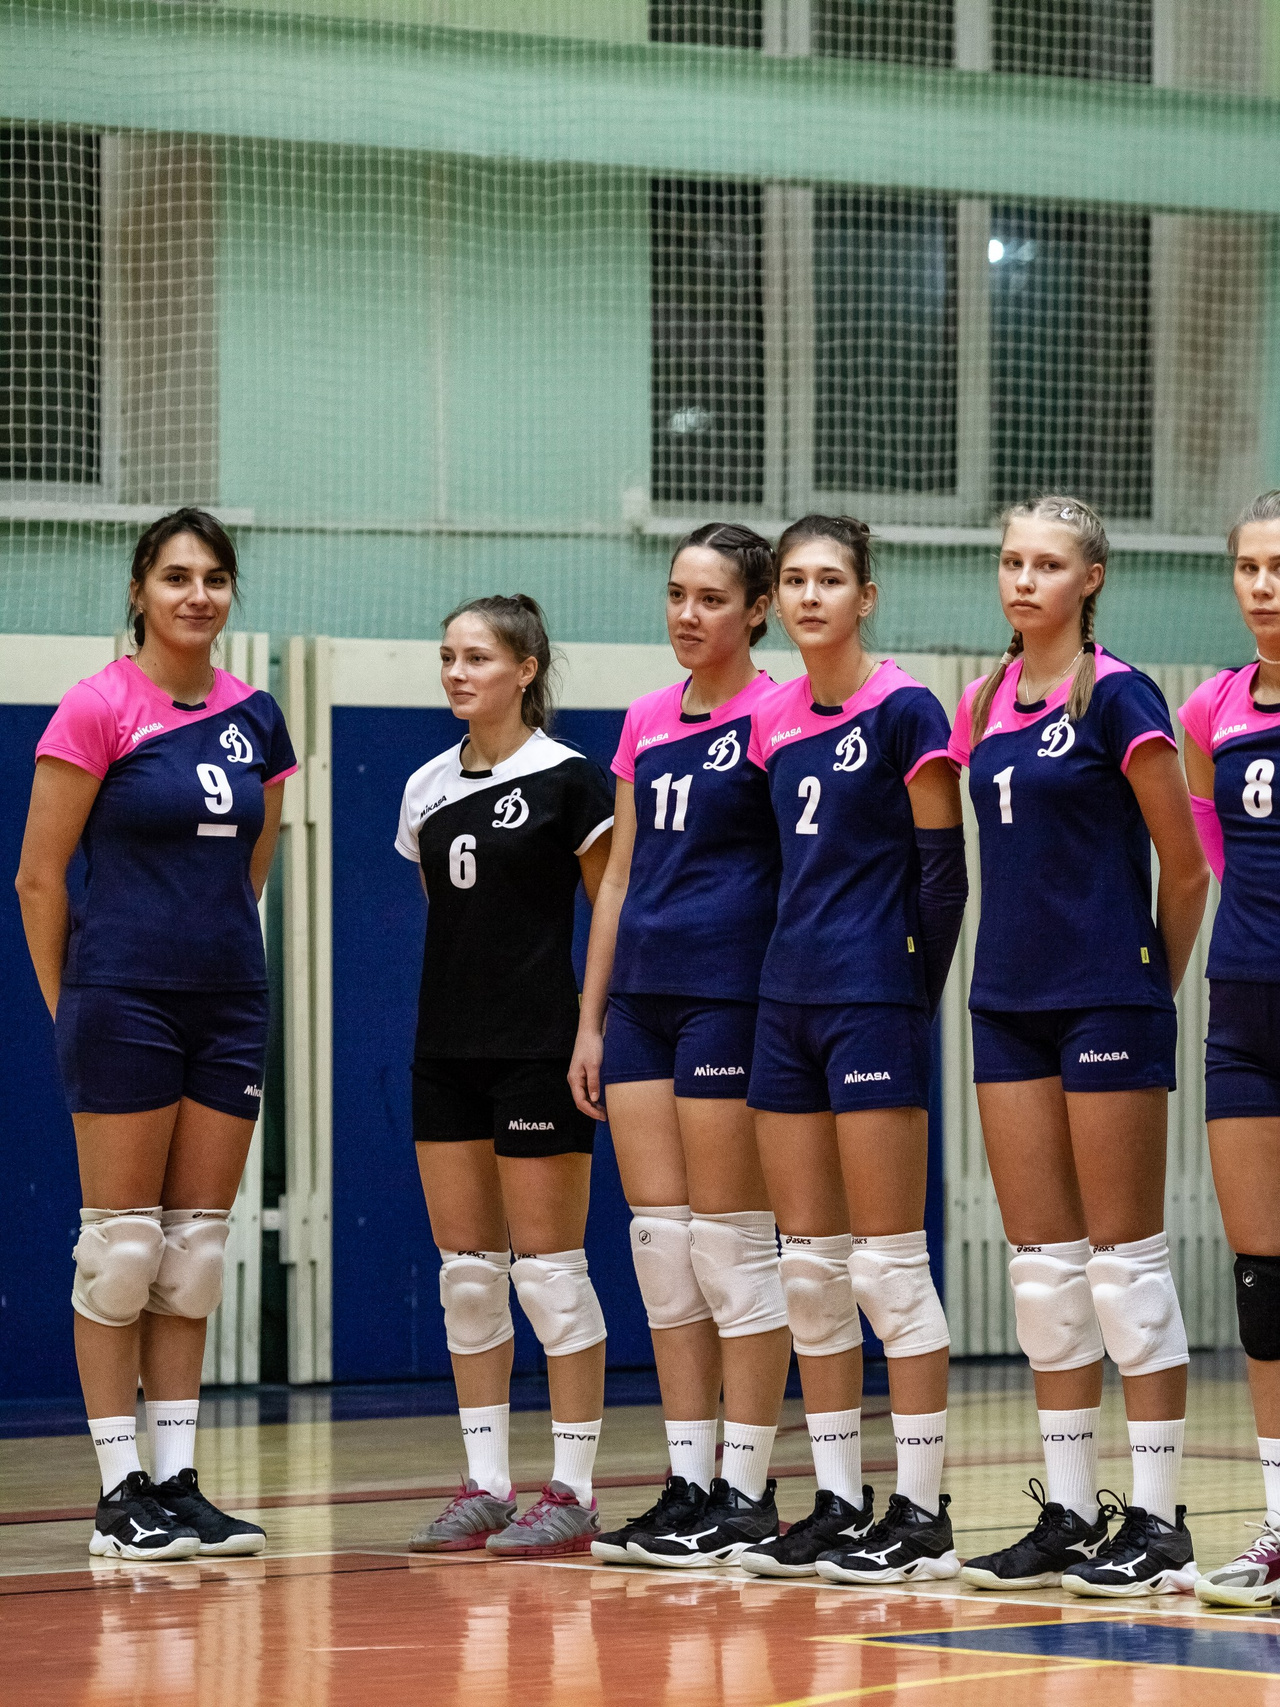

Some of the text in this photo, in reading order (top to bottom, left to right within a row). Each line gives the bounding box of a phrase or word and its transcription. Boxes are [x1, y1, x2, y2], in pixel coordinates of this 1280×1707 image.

[196, 763, 233, 814] 9
[651, 773, 693, 831] 11
[795, 776, 821, 835] 2
[993, 766, 1015, 824] 1
[1242, 759, 1275, 818] 8
[449, 834, 476, 889] 6
